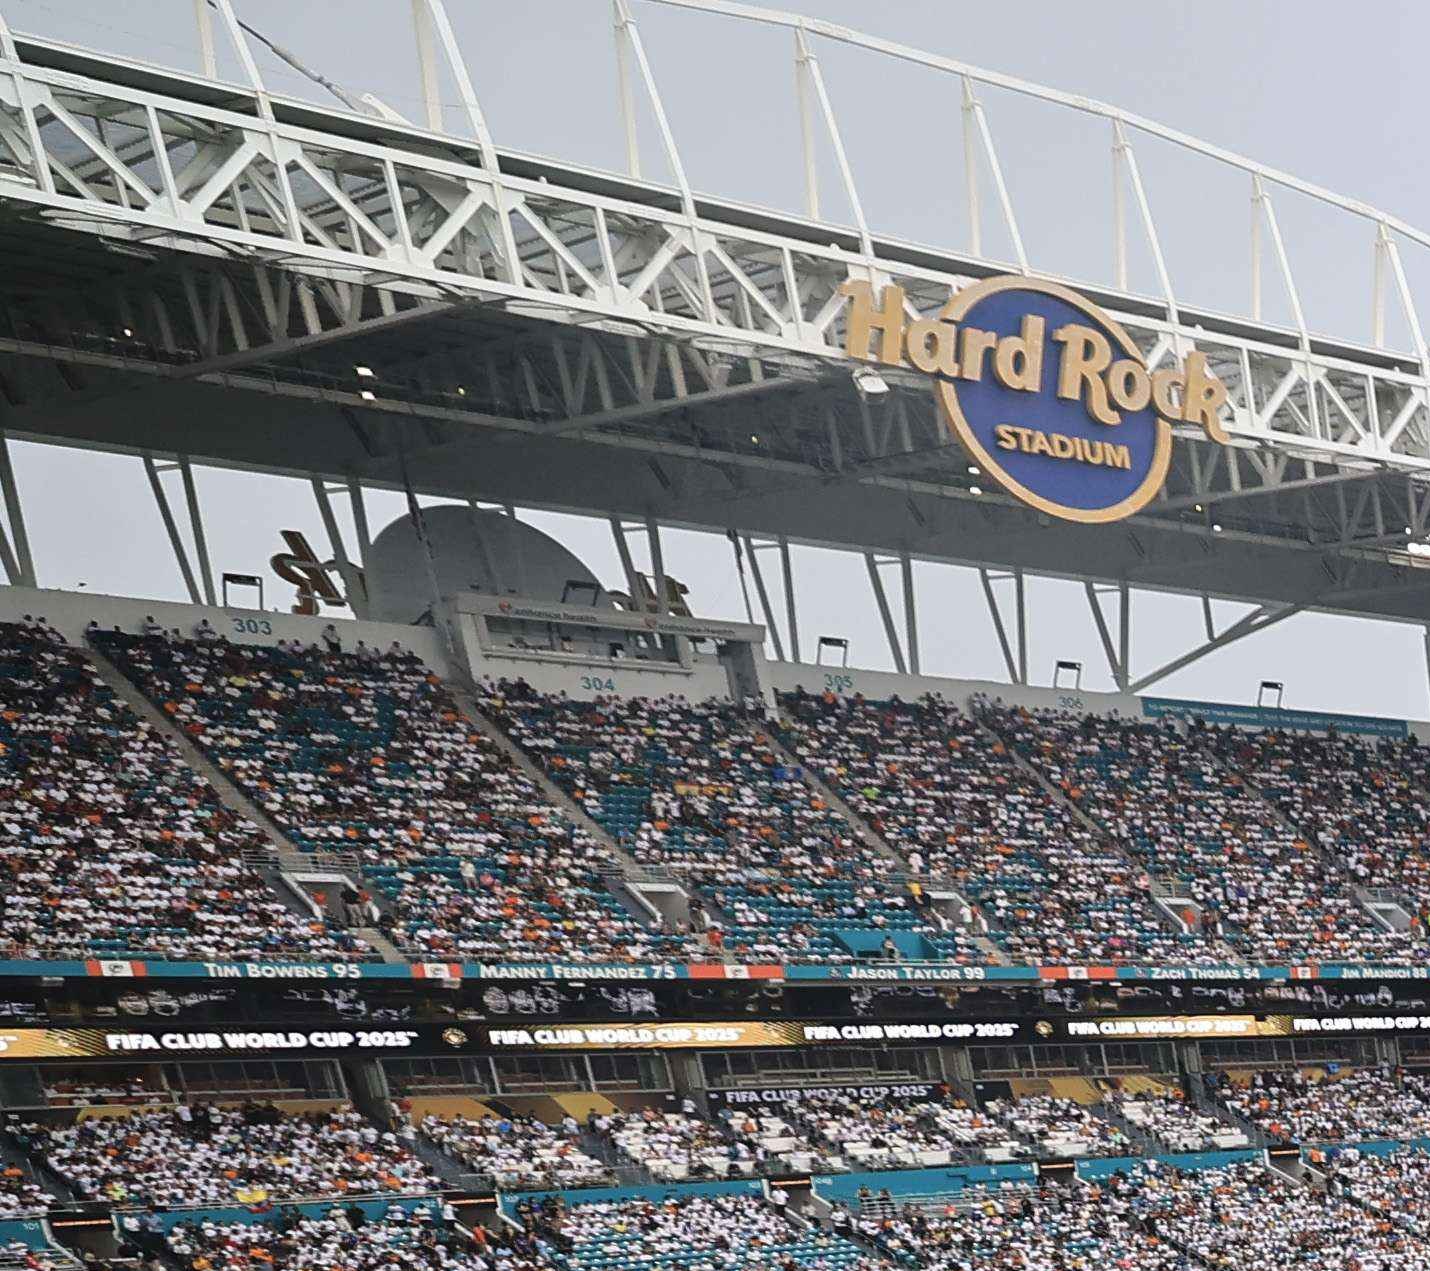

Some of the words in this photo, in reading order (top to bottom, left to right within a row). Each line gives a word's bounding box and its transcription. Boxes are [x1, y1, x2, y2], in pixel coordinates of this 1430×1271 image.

[838, 278, 1046, 392] Hard
[1053, 323, 1231, 446] Rock
[994, 424, 1131, 470] STADIUM
[232, 619, 272, 636] 303
[581, 676, 615, 691] 304
[203, 963, 240, 978] TIM
[245, 963, 328, 978] BOWENS
[332, 963, 361, 979] 95
[480, 965, 547, 978] MANNY
[552, 965, 647, 979] FERNANDEZ
[651, 965, 677, 979] 75
[847, 967, 898, 979] JASON
[902, 967, 960, 979] TAYLOR
[963, 967, 985, 979] 99
[106, 1034, 160, 1050] FIFA
[160, 1033, 222, 1049] CLUB
[221, 1032, 307, 1048] WORLD
[307, 1031, 356, 1047] CUP
[725, 1091, 759, 1103] FIFA
